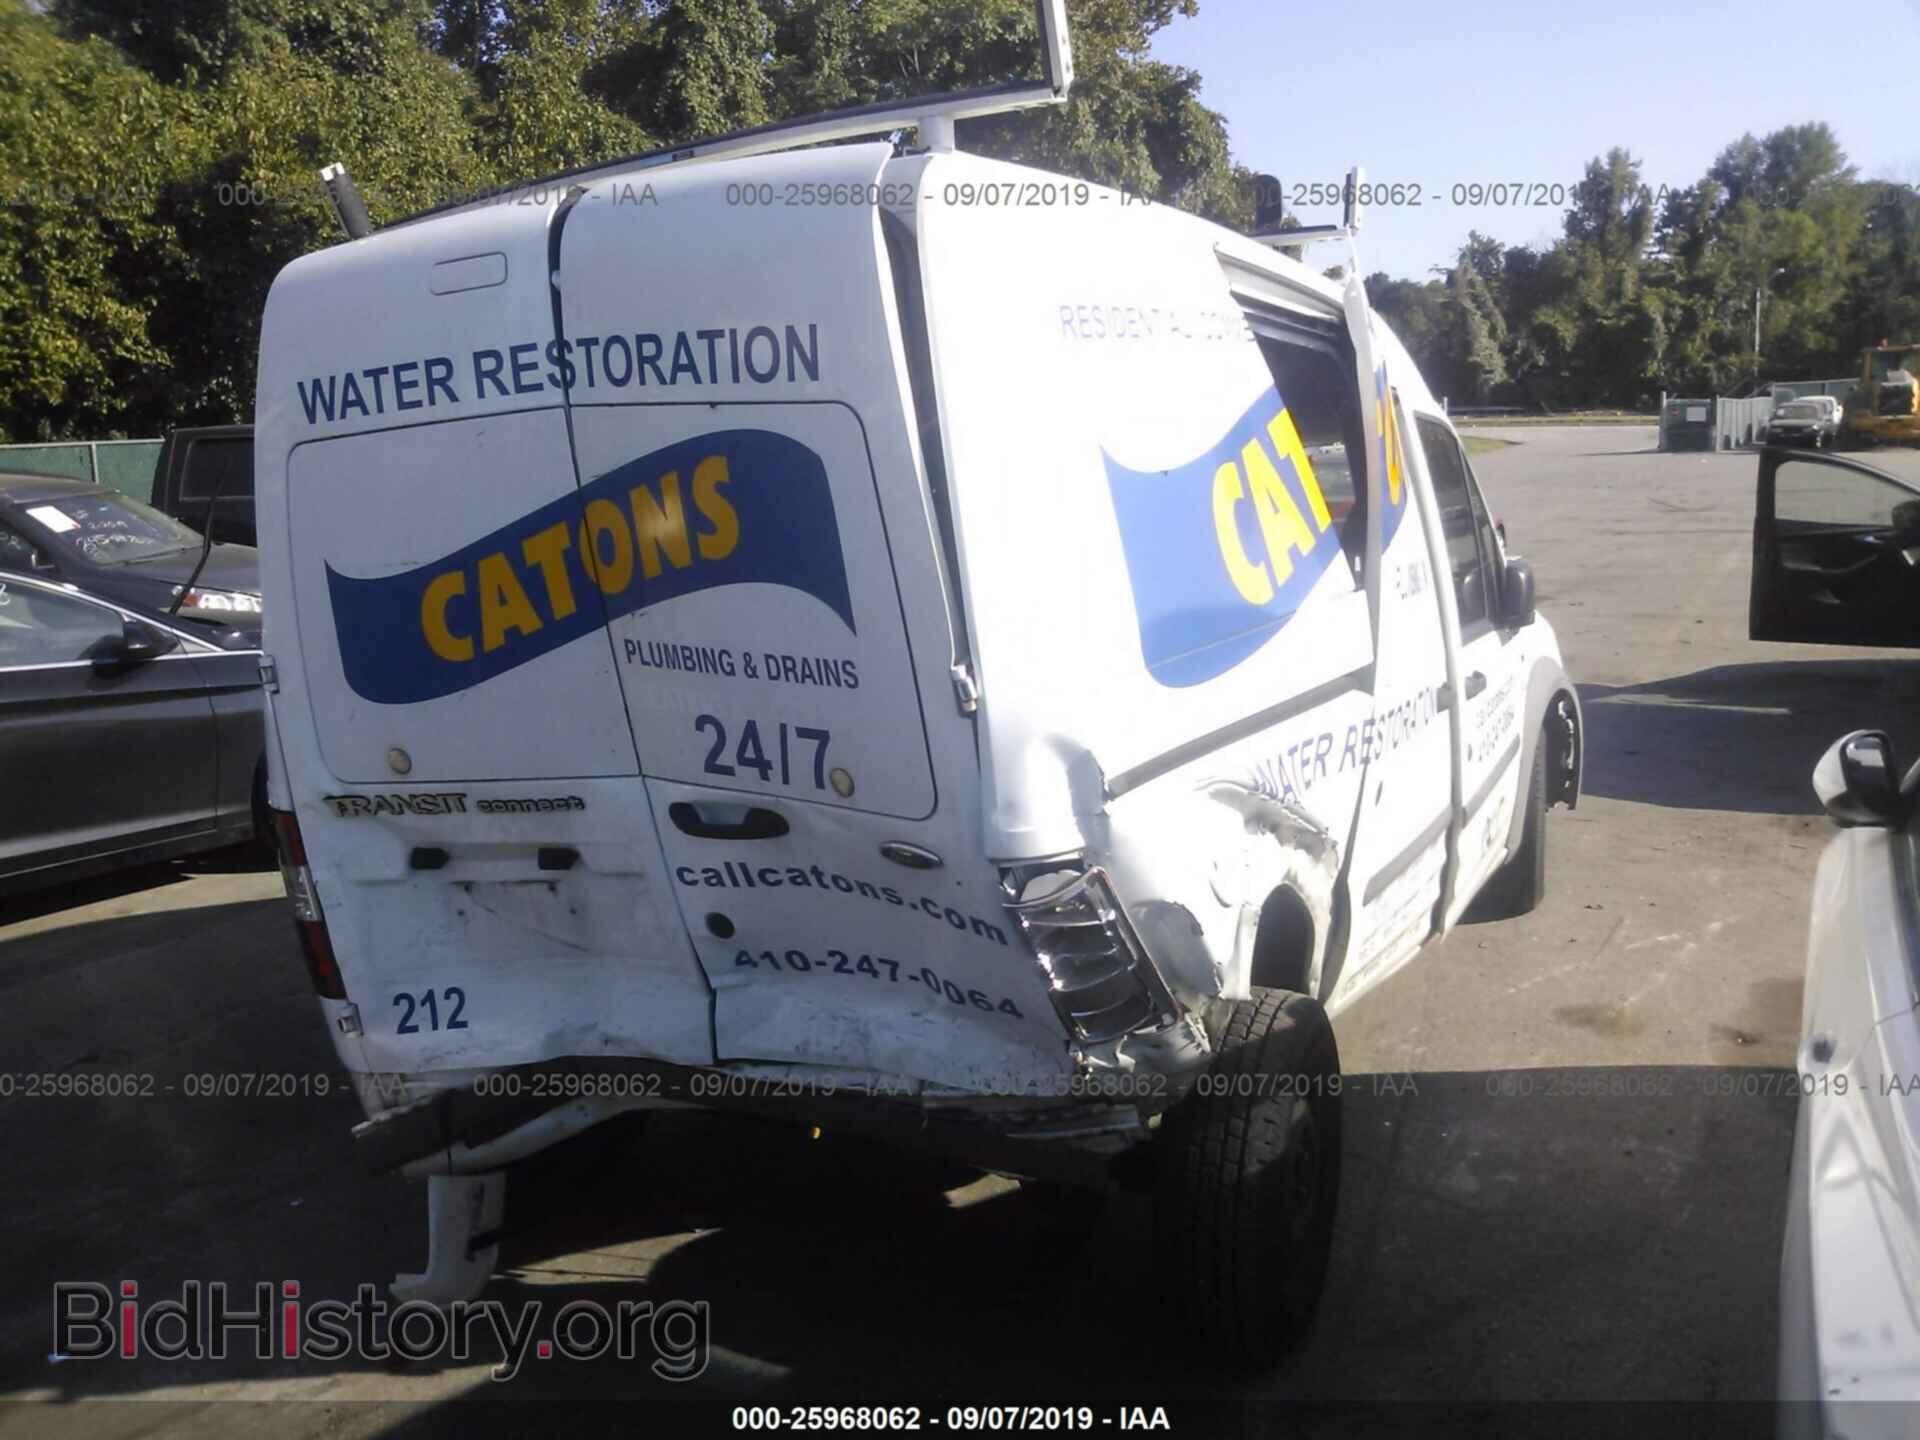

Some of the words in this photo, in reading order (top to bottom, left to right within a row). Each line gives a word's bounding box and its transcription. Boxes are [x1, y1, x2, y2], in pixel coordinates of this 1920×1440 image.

[297, 356, 459, 425] WATER
[472, 323, 820, 399] RESTORATION
[420, 455, 741, 662] CATONS
[623, 638, 737, 678] PLUMBING
[743, 651, 760, 680] &
[763, 653, 860, 690] DRAINS
[694, 713, 831, 791] 24/7
[1338, 686, 1438, 774] RESTORATON
[322, 792, 468, 818] TRANSIT
[476, 795, 586, 813] connect
[675, 861, 1009, 946] callcatons.com
[393, 985, 470, 1036] 212
[733, 949, 1025, 1020] 410-247-0064
